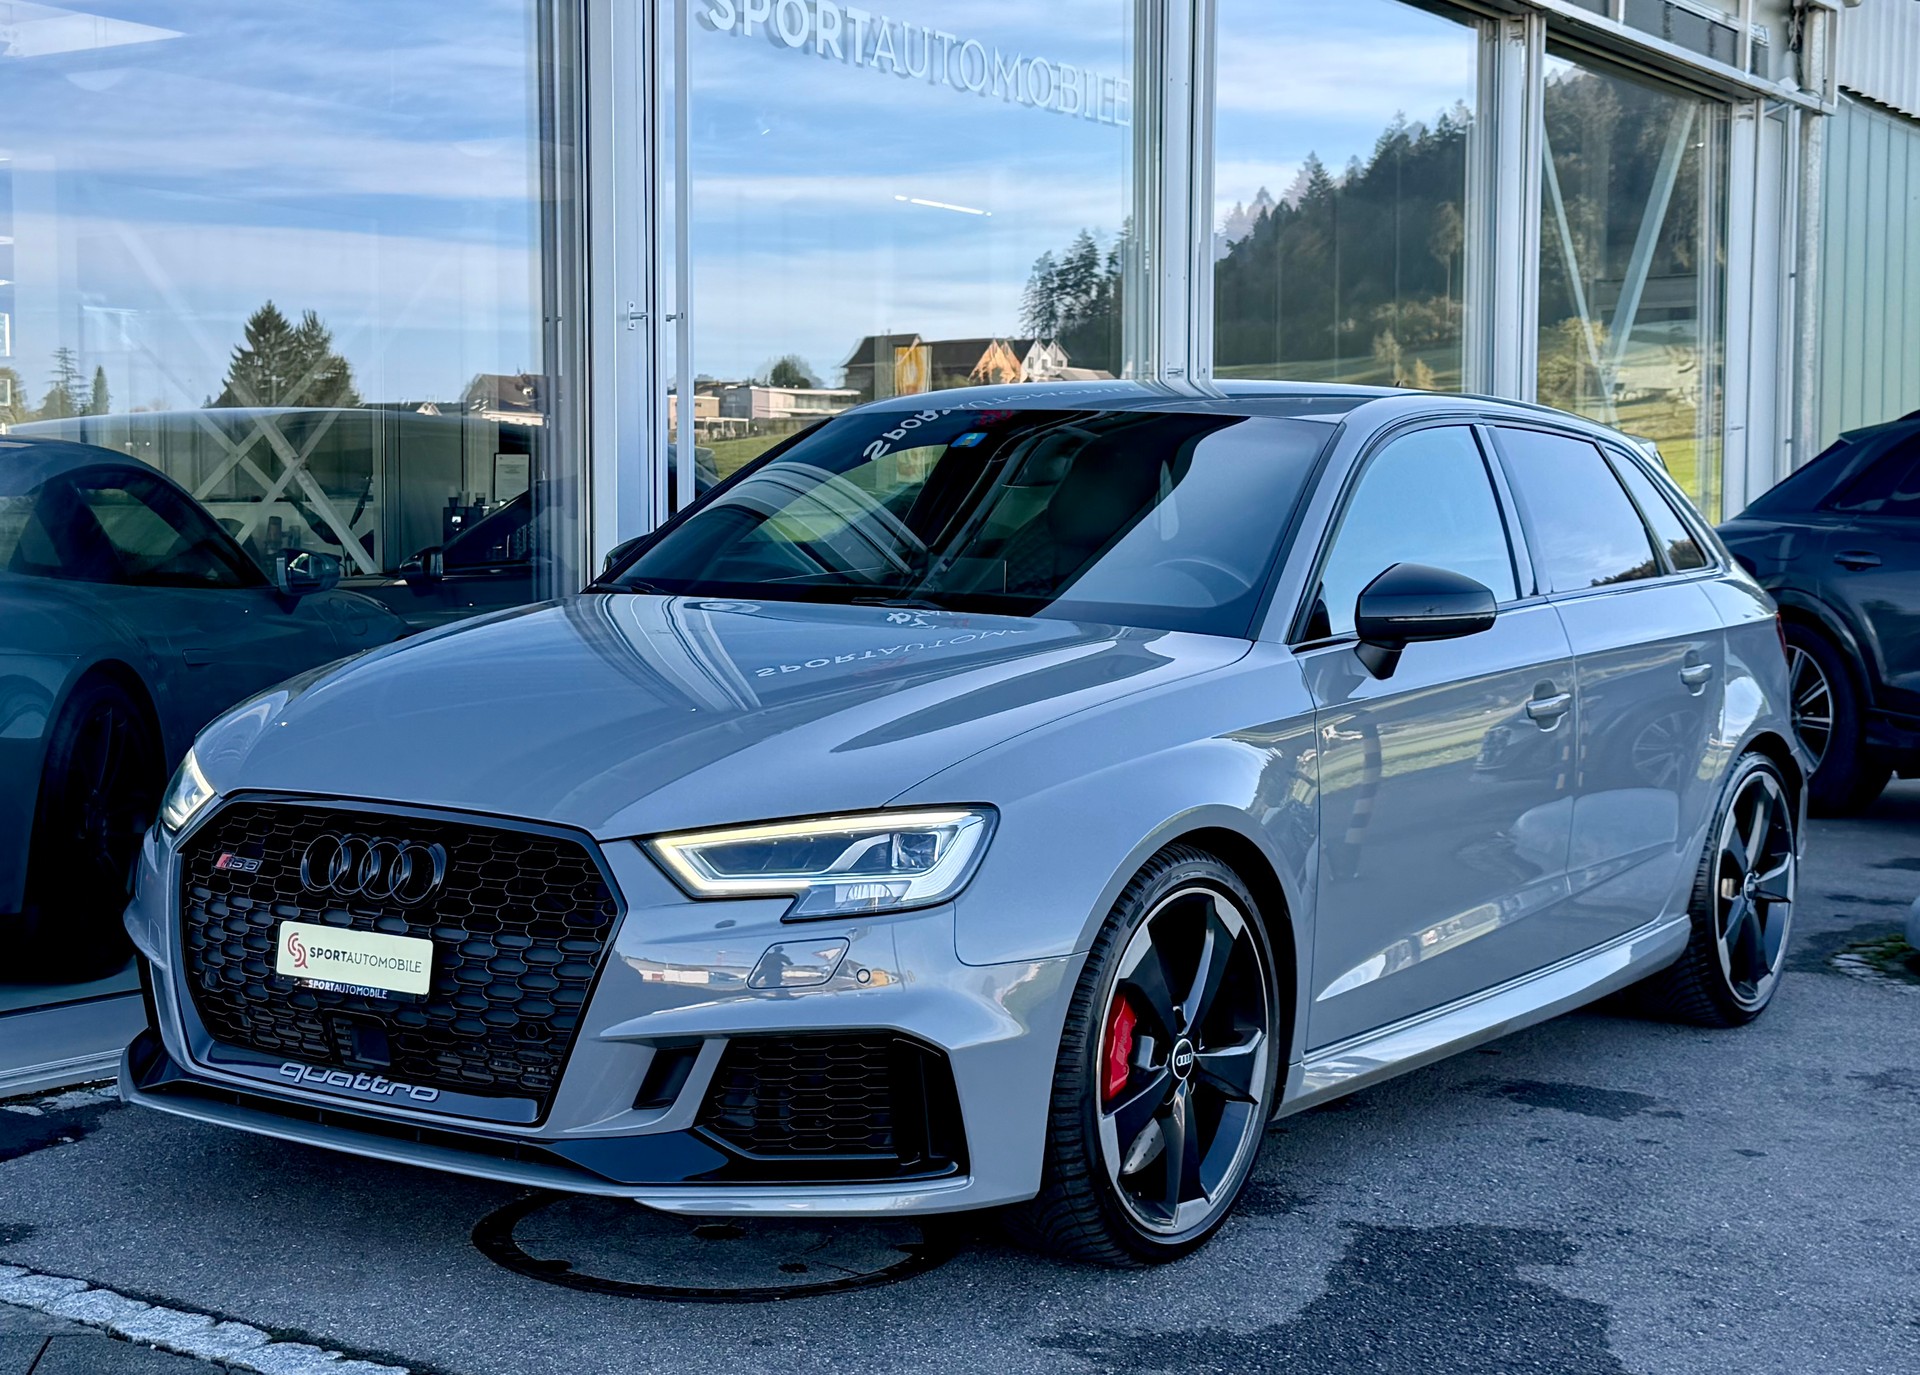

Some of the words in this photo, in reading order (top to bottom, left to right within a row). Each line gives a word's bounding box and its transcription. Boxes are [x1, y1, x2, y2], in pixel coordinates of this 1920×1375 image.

[309, 946, 422, 974] SPORTAUTOMOBILE
[308, 979, 388, 999] SPORTAUTOMOBILE
[279, 1061, 440, 1102] quattro
